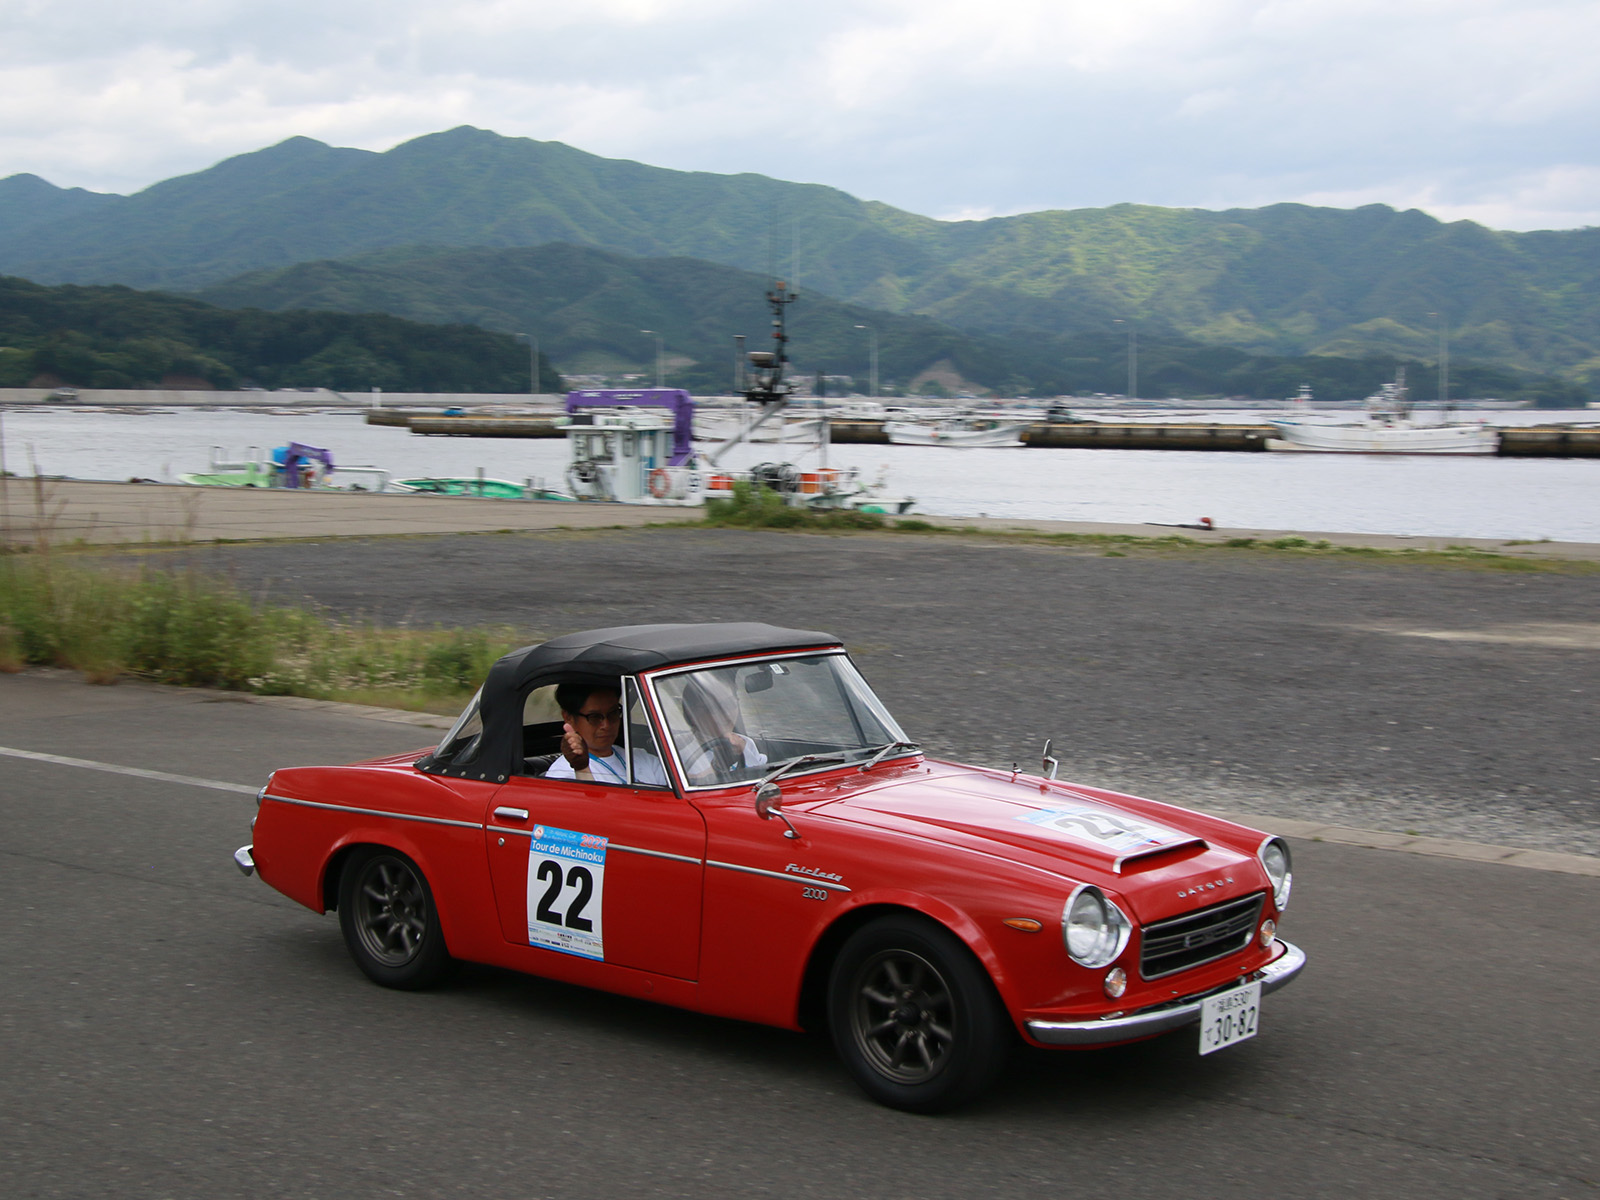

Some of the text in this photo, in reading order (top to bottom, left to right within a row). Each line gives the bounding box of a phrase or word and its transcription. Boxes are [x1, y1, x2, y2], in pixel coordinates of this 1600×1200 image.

[1054, 812, 1147, 840] 22
[531, 840, 549, 852] Tour
[549, 844, 560, 854] de
[560, 846, 604, 863] Michinoku
[580, 834, 607, 851] 2023
[536, 859, 594, 933] 22
[802, 886, 828, 901] 2000
[1177, 877, 1234, 898] DATSUN
